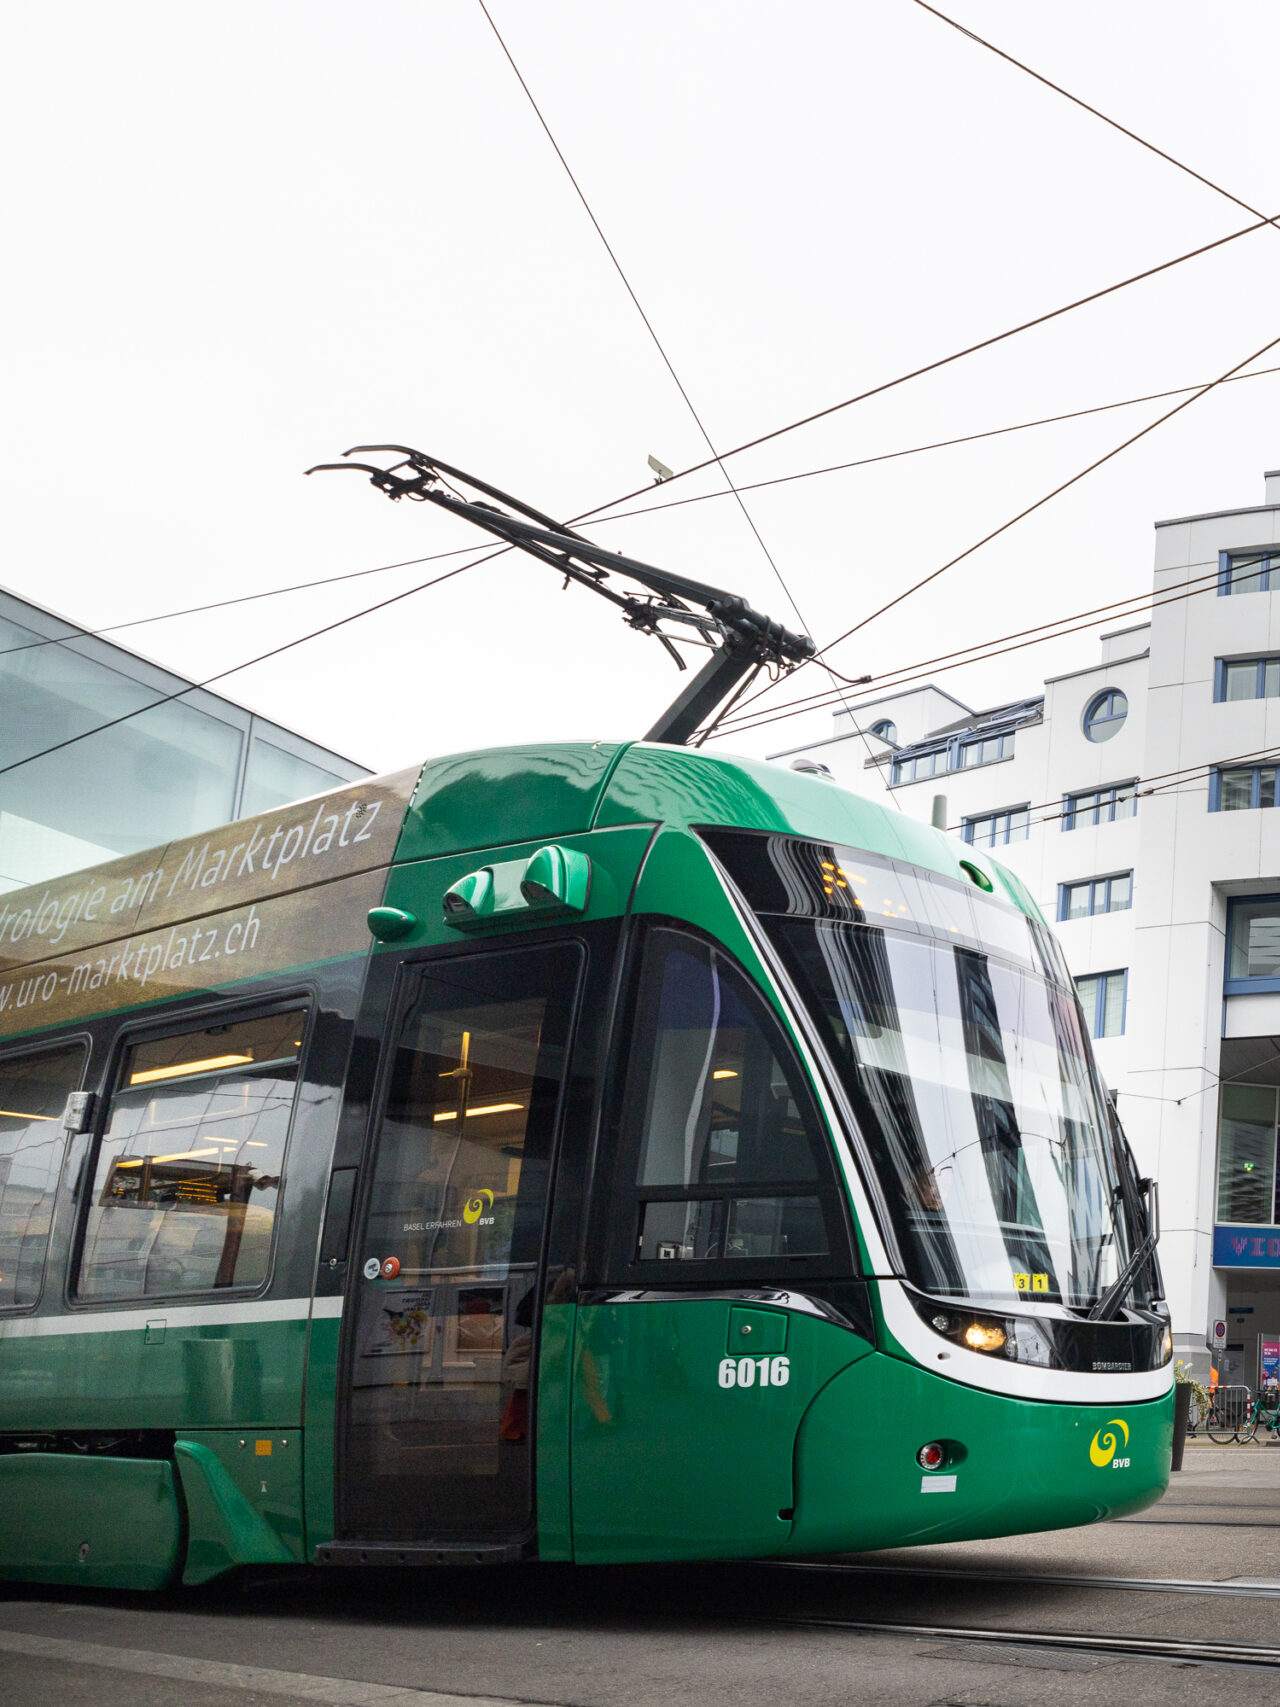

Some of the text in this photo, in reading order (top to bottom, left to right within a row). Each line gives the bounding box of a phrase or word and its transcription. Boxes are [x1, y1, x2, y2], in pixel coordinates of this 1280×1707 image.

[0, 801, 382, 944] rologie am Marktplatz
[403, 1220, 462, 1232] BASEL ERFAHREN
[479, 1217, 495, 1226] BVB
[718, 1356, 790, 1389] 6016
[1112, 1457, 1131, 1469] BVB
